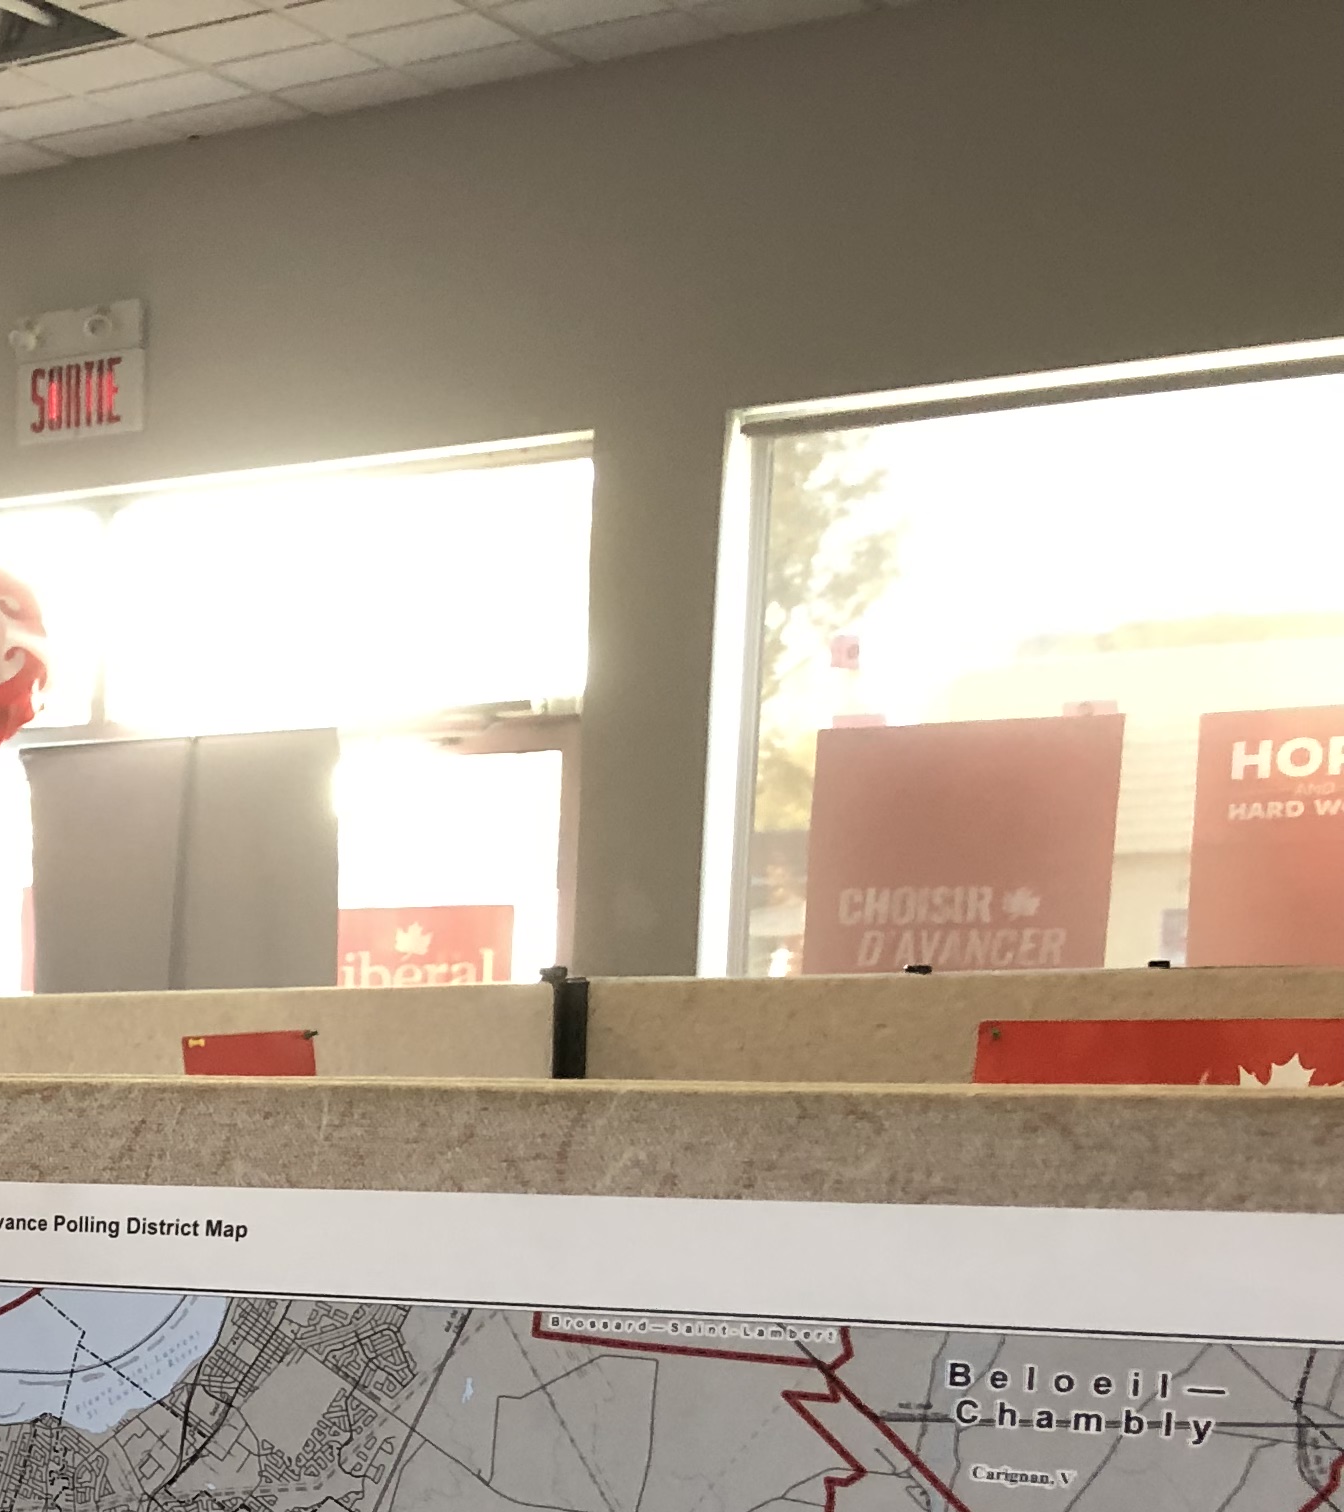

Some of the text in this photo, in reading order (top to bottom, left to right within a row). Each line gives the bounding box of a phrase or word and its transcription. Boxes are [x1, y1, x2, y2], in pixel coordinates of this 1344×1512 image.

[31, 357, 122, 433] SORTIE
[1228, 799, 1344, 820] HARD W
[838, 886, 993, 925] CHOISIR
[54, 1215, 120, 1238] Polling
[127, 1217, 200, 1237] District
[205, 1219, 249, 1242] Map
[957, 1400, 1213, 1444] Chambly
